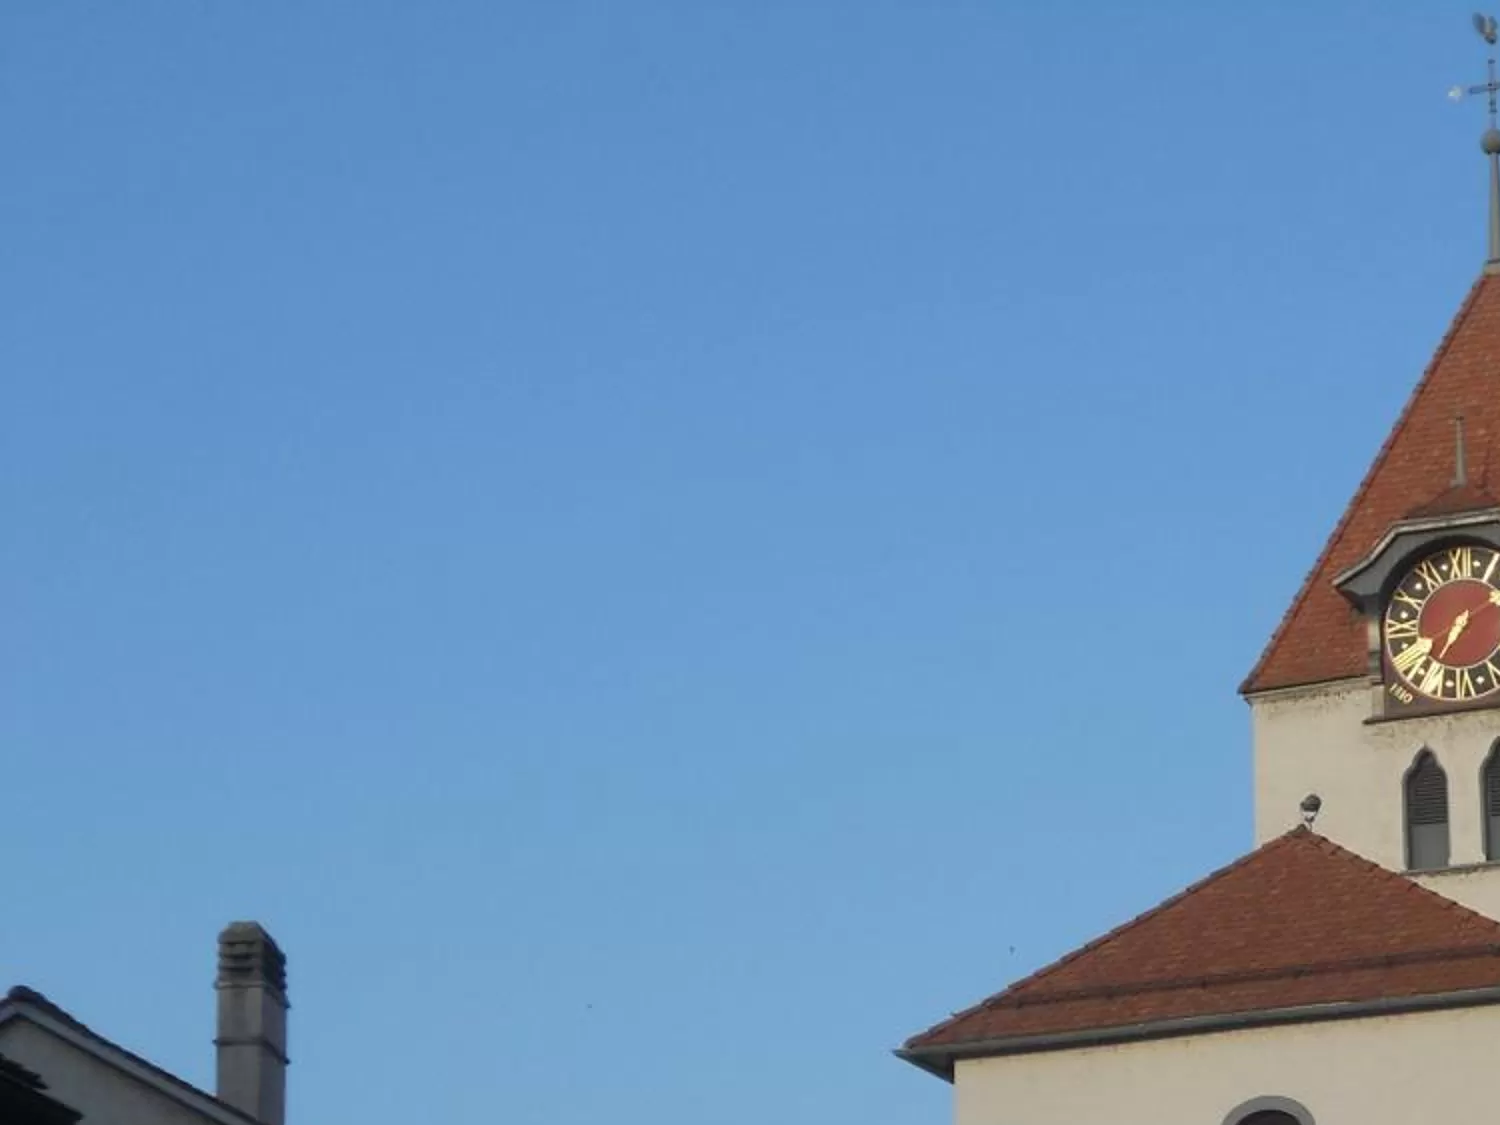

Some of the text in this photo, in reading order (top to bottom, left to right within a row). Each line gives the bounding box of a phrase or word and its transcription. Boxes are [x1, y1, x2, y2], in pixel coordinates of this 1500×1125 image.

[1414, 560, 1444, 592] XI
[1449, 547, 1472, 579] XII
[1482, 552, 1500, 582] I
[1393, 588, 1424, 610] X
[1386, 619, 1419, 639] IX
[1455, 668, 1477, 700] VI
